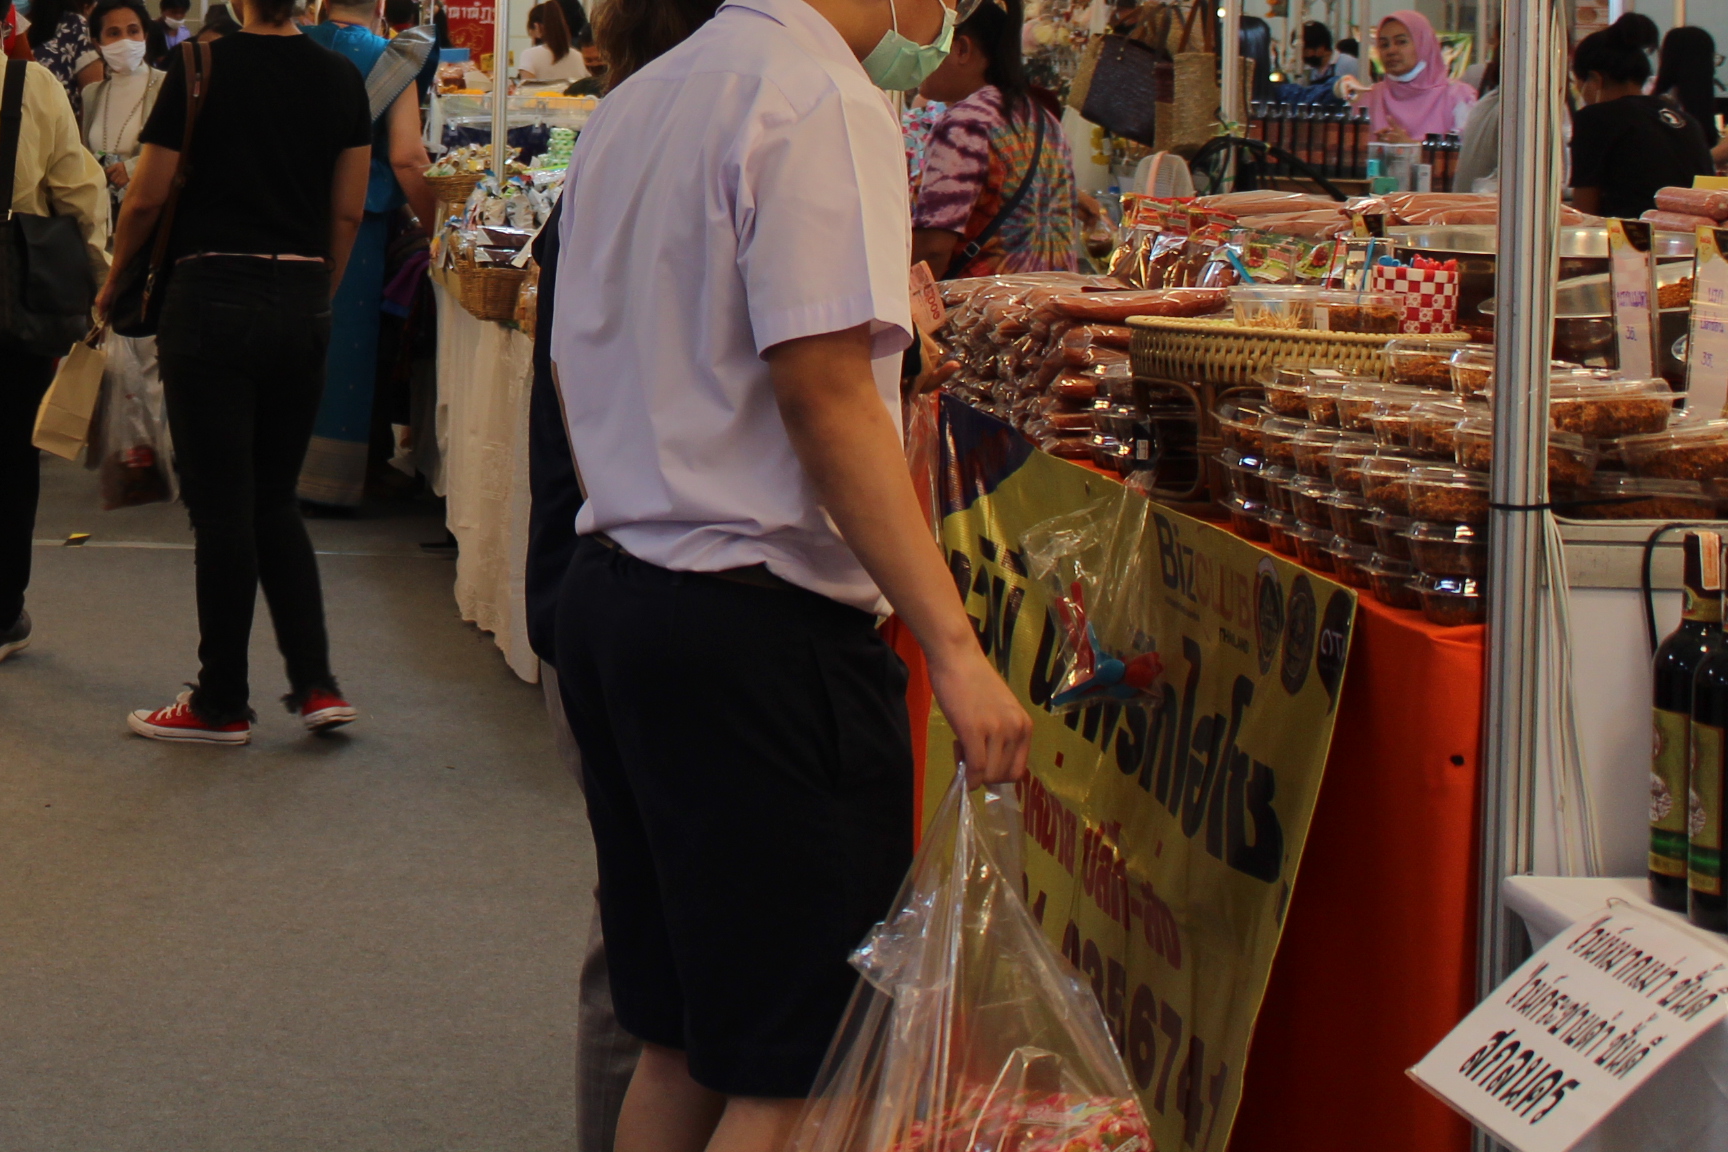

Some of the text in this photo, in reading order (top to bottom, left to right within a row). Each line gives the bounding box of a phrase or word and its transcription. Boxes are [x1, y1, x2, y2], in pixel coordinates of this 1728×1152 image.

[1152, 510, 1253, 630] BizCLUB
[1567, 915, 1687, 999] ไวน์หมากเม่า
[1505, 960, 1668, 1081] ไวน์กระชายดำ ชั้นดี
[1458, 1028, 1581, 1126] สกลนคร
